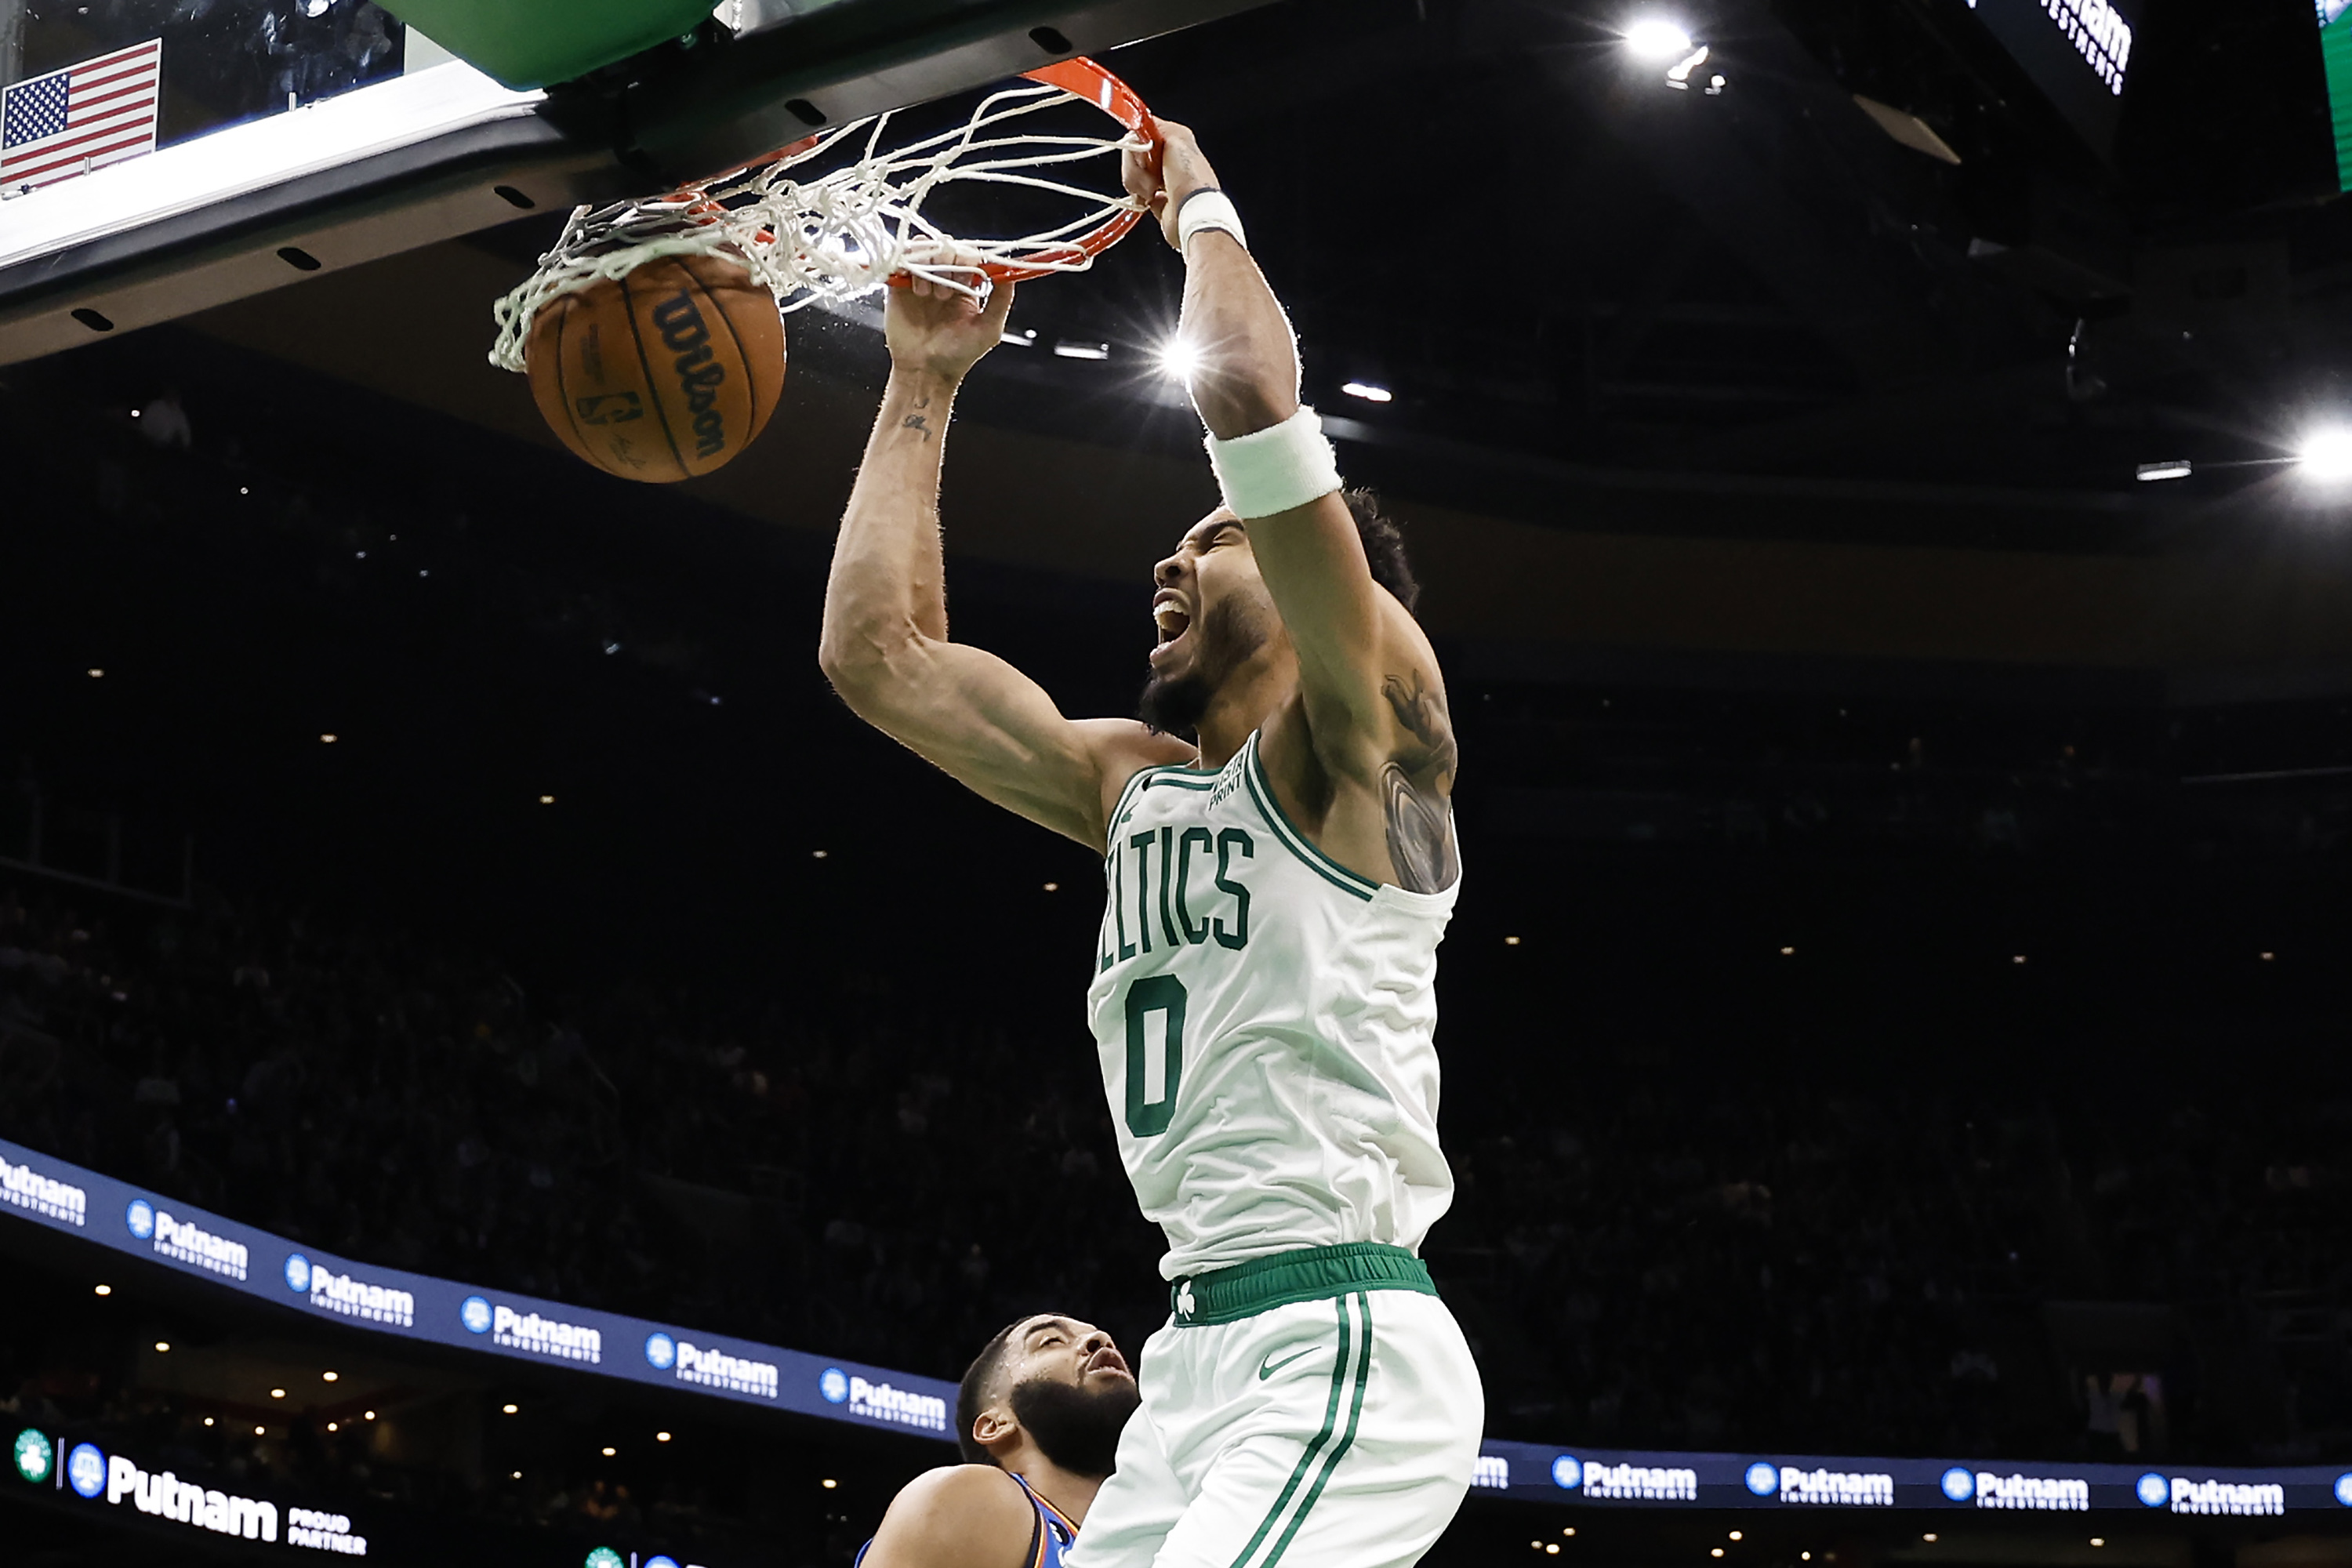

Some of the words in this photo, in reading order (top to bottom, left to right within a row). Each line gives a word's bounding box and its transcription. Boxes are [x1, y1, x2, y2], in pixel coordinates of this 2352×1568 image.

[652, 287, 725, 460] Wilson
[1208, 771, 1242, 811] PRINT
[1124, 974, 1188, 1138] 0
[154, 1210, 249, 1269] Putnam
[311, 1265, 414, 1315] Putnam
[494, 1305, 601, 1352] Putnam
[677, 1341, 778, 1387] Putnam
[850, 1377, 946, 1420] Putnam
[1583, 1461, 1697, 1489] Putnam
[1780, 1467, 1893, 1494] Putnam
[1976, 1472, 2089, 1500] Putnam
[2171, 1478, 2284, 1504] Putnam
[107, 1455, 278, 1542] Putnam
[288, 1526, 368, 1556] PARTNER
[289, 1507, 351, 1534] PROUD
